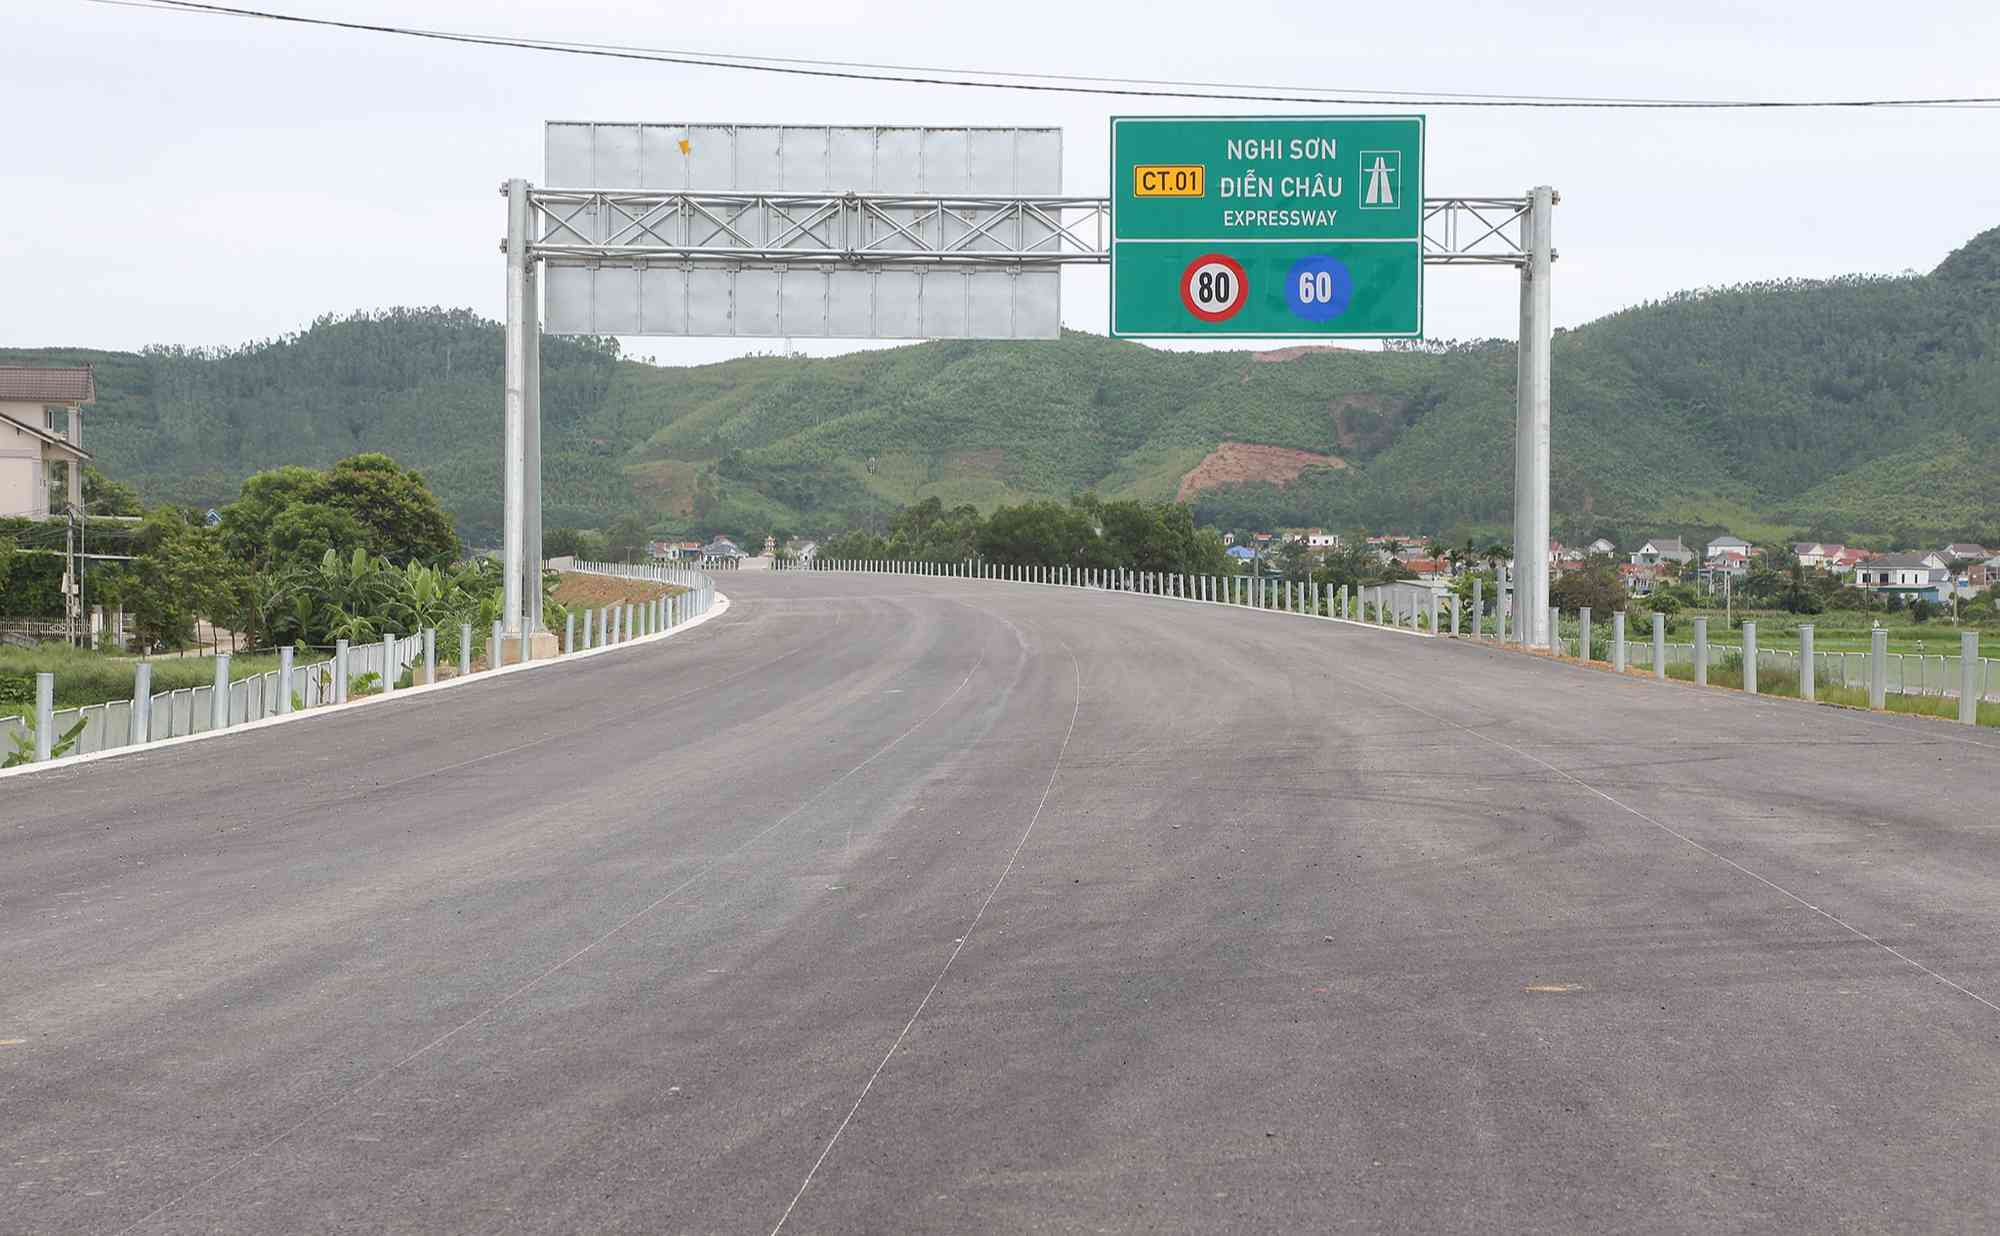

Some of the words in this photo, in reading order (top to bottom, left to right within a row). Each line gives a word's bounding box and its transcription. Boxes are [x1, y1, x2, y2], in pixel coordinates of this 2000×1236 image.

[1227, 139, 1282, 160] NGHI
[1289, 137, 1337, 160] SƠN
[1142, 171, 1198, 191] CT.01
[1220, 169, 1273, 198] DIỄN
[1280, 173, 1342, 198] CHÂU
[1224, 210, 1337, 226] EXPRESSWAY
[1198, 271, 1230, 303] 80
[1299, 271, 1332, 303] 60
